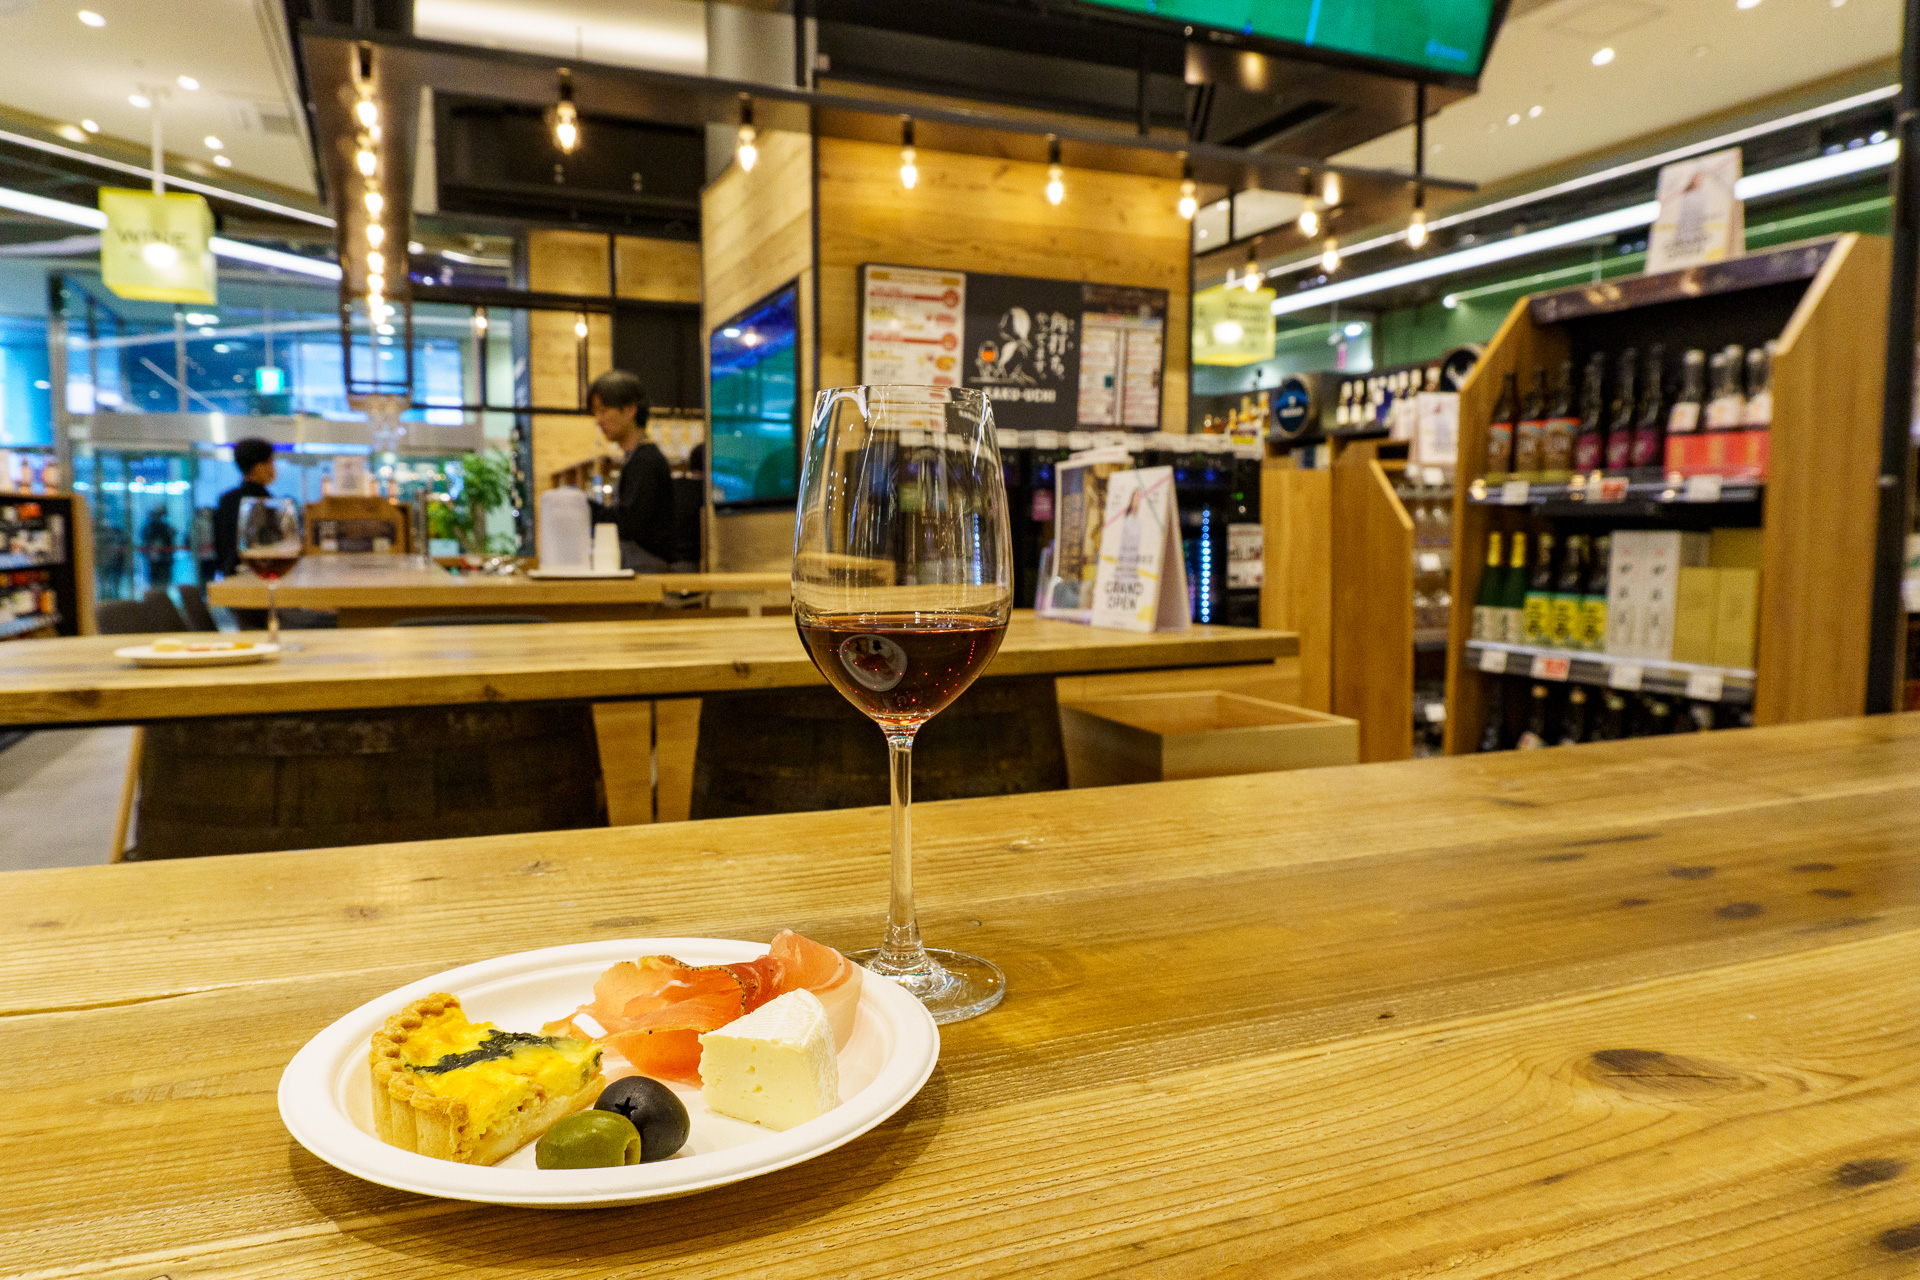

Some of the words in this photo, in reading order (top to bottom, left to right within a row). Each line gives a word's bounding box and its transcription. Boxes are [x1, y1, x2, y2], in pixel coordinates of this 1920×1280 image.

[117, 229, 187, 248] WINE
[1104, 580, 1144, 596] GRAND
[1107, 594, 1138, 610] OPEN
